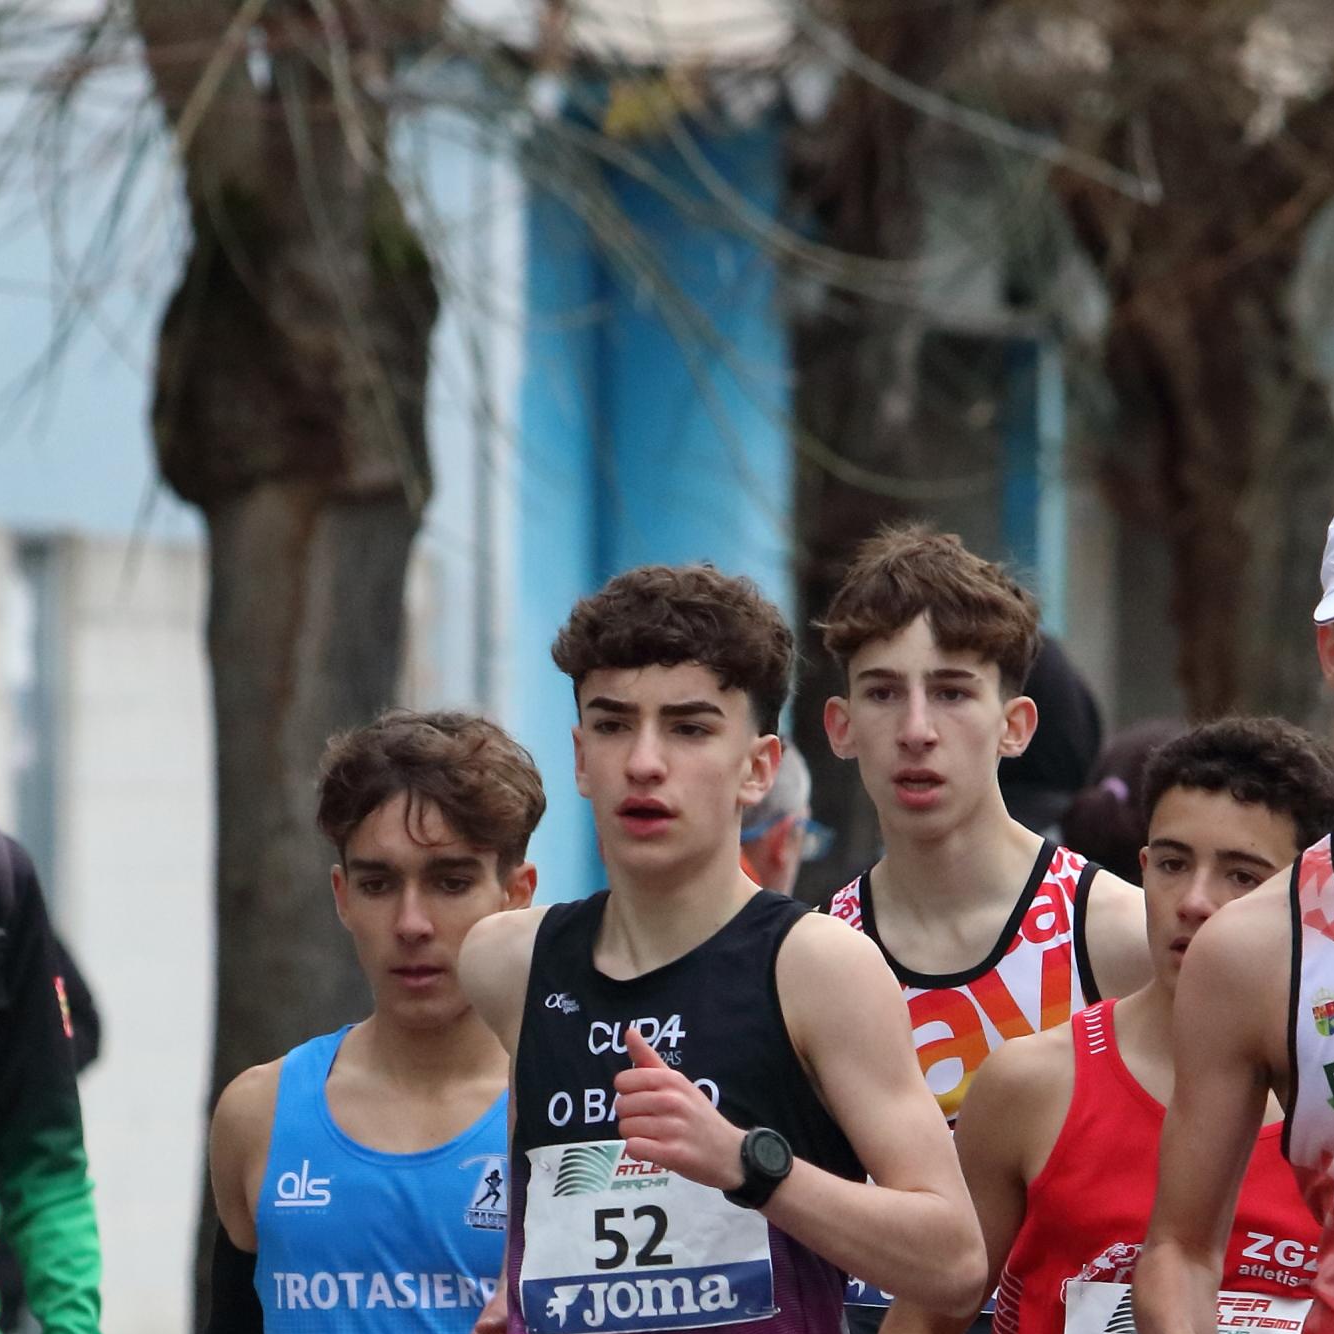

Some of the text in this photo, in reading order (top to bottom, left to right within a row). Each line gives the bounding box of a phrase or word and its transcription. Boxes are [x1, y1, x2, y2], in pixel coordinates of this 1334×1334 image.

[548, 1091, 573, 1127] O
[594, 1205, 673, 1270] 52
[1238, 1264, 1311, 1287] atletis
[1217, 1298, 1272, 1313] FEA
